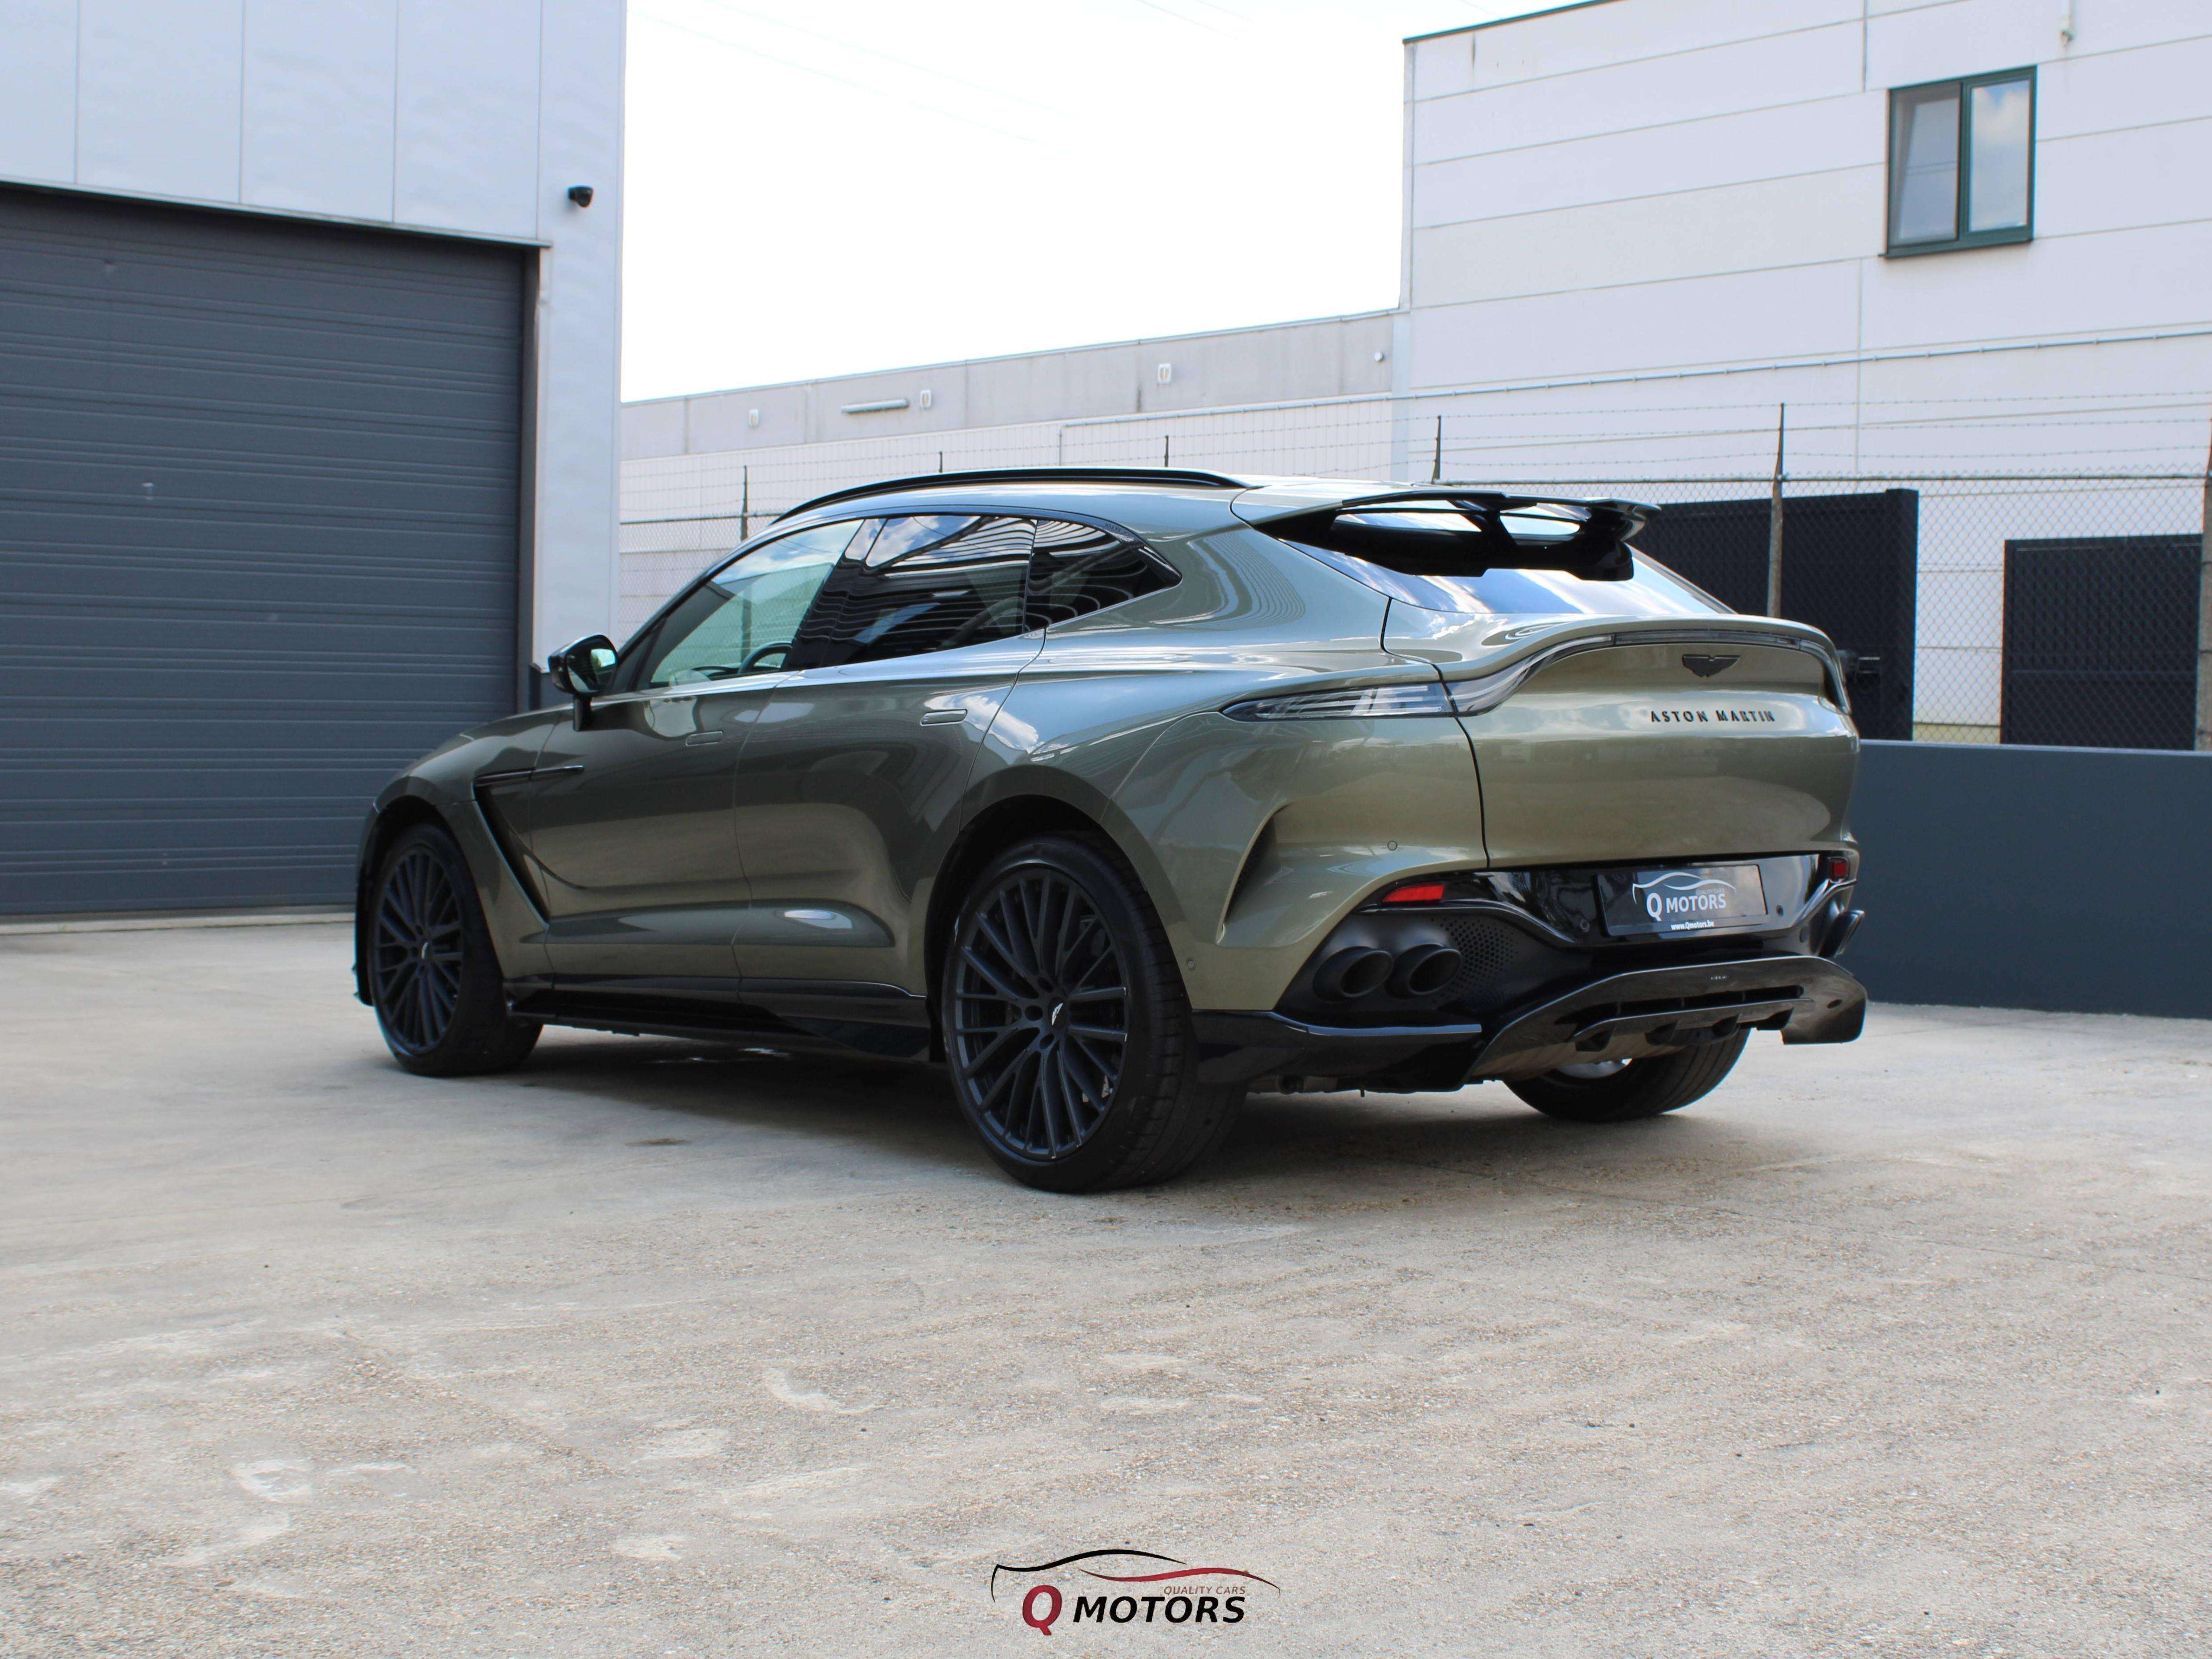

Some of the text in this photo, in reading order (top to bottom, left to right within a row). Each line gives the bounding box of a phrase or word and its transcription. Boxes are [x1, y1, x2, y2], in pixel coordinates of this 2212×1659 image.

[1651, 710, 1775, 722] ASTON MARTIN
[1646, 892, 1726, 921] Q MOTORS
[1670, 919, 1715, 930] www.Qmotors.be
